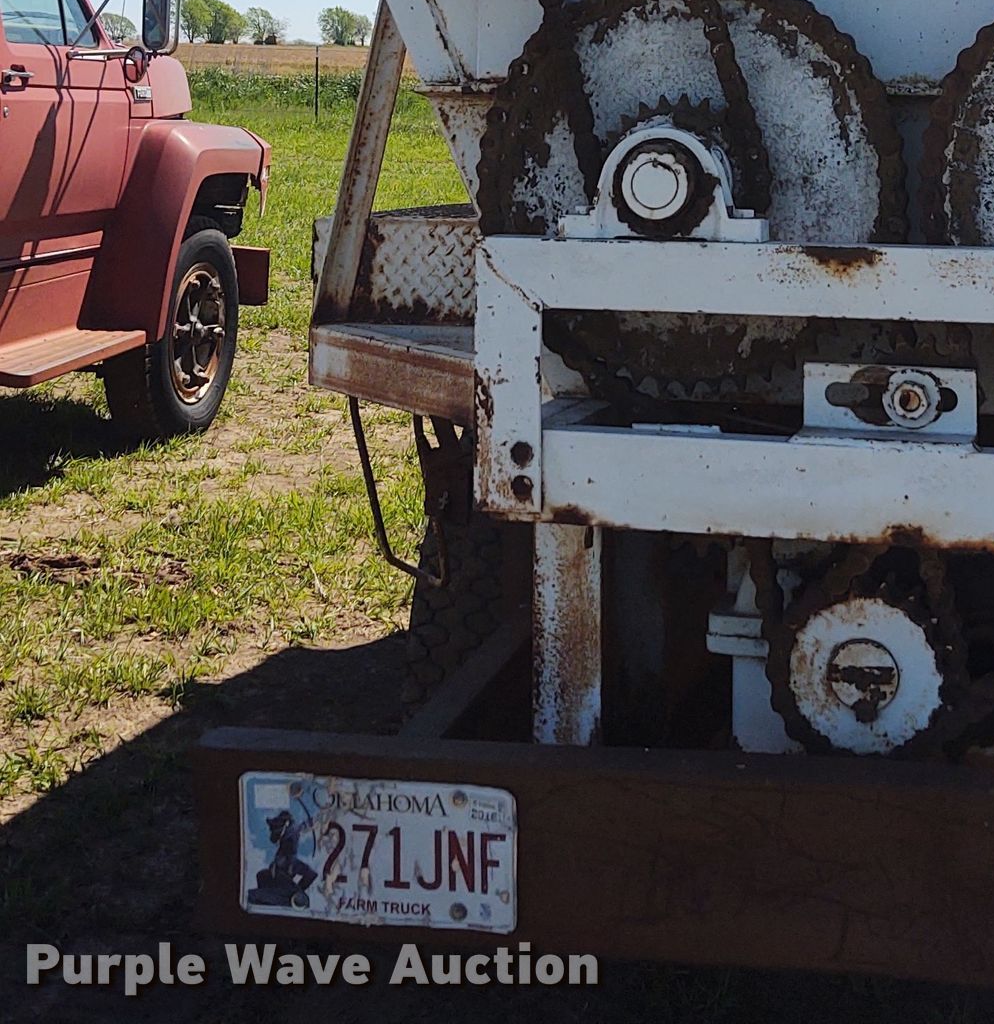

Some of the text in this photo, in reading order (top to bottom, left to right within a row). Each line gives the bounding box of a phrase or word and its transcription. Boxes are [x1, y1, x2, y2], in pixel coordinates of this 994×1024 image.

[322, 821, 507, 895] 271JNF
[336, 897, 432, 915] FARM TRUCK
